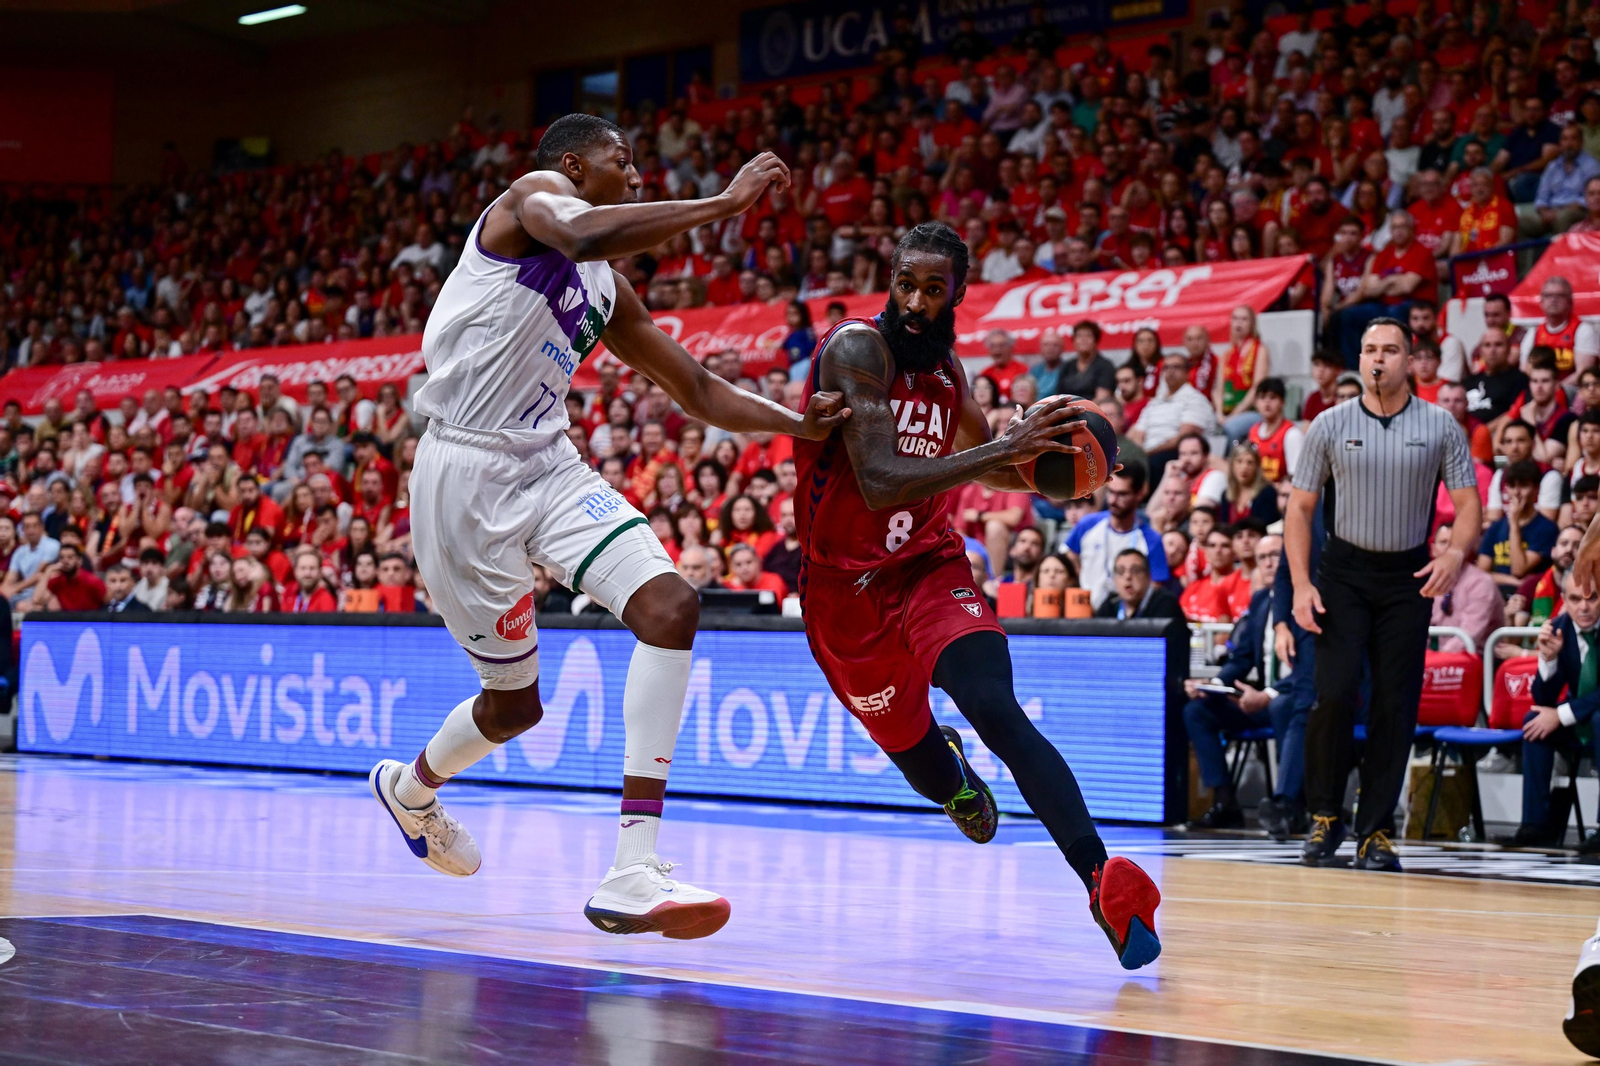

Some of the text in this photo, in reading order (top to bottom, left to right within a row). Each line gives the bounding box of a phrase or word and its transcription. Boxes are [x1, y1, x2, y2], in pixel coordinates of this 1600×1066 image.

[519, 381, 557, 430] 77
[886, 511, 913, 553] 8
[127, 643, 407, 749] Movistar
